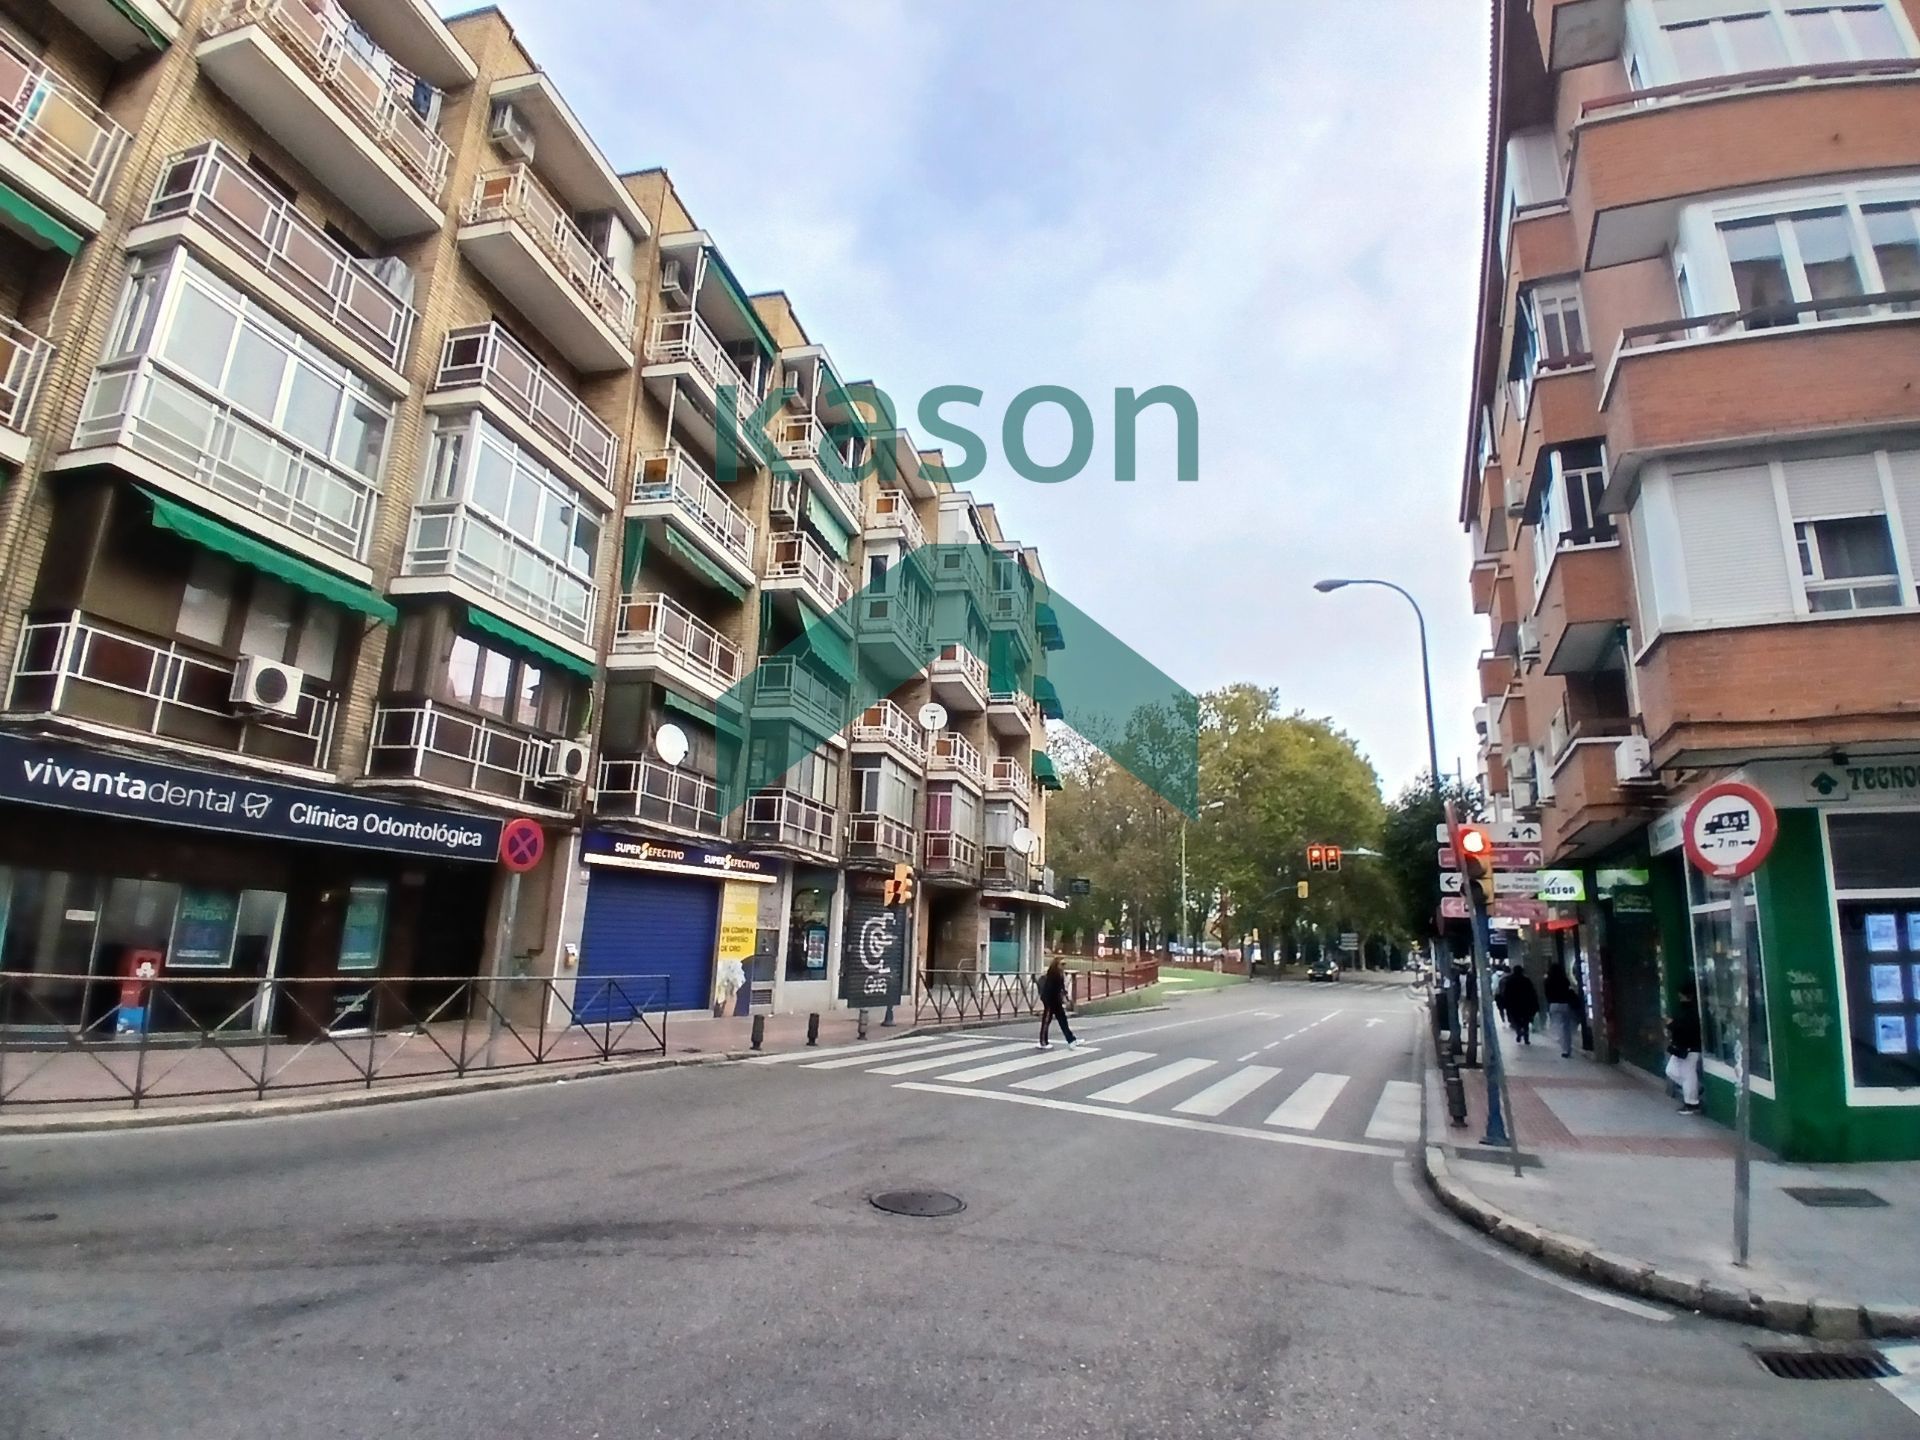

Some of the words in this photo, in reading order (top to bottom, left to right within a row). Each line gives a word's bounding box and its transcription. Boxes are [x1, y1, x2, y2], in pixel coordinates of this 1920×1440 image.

[1846, 765, 1920, 790] TECNO
[23, 757, 236, 813] vivantadental
[289, 802, 358, 831] Clínica
[363, 813, 482, 848] Odontológica
[1717, 838, 1724, 848] 7
[1728, 839, 1739, 848] m
